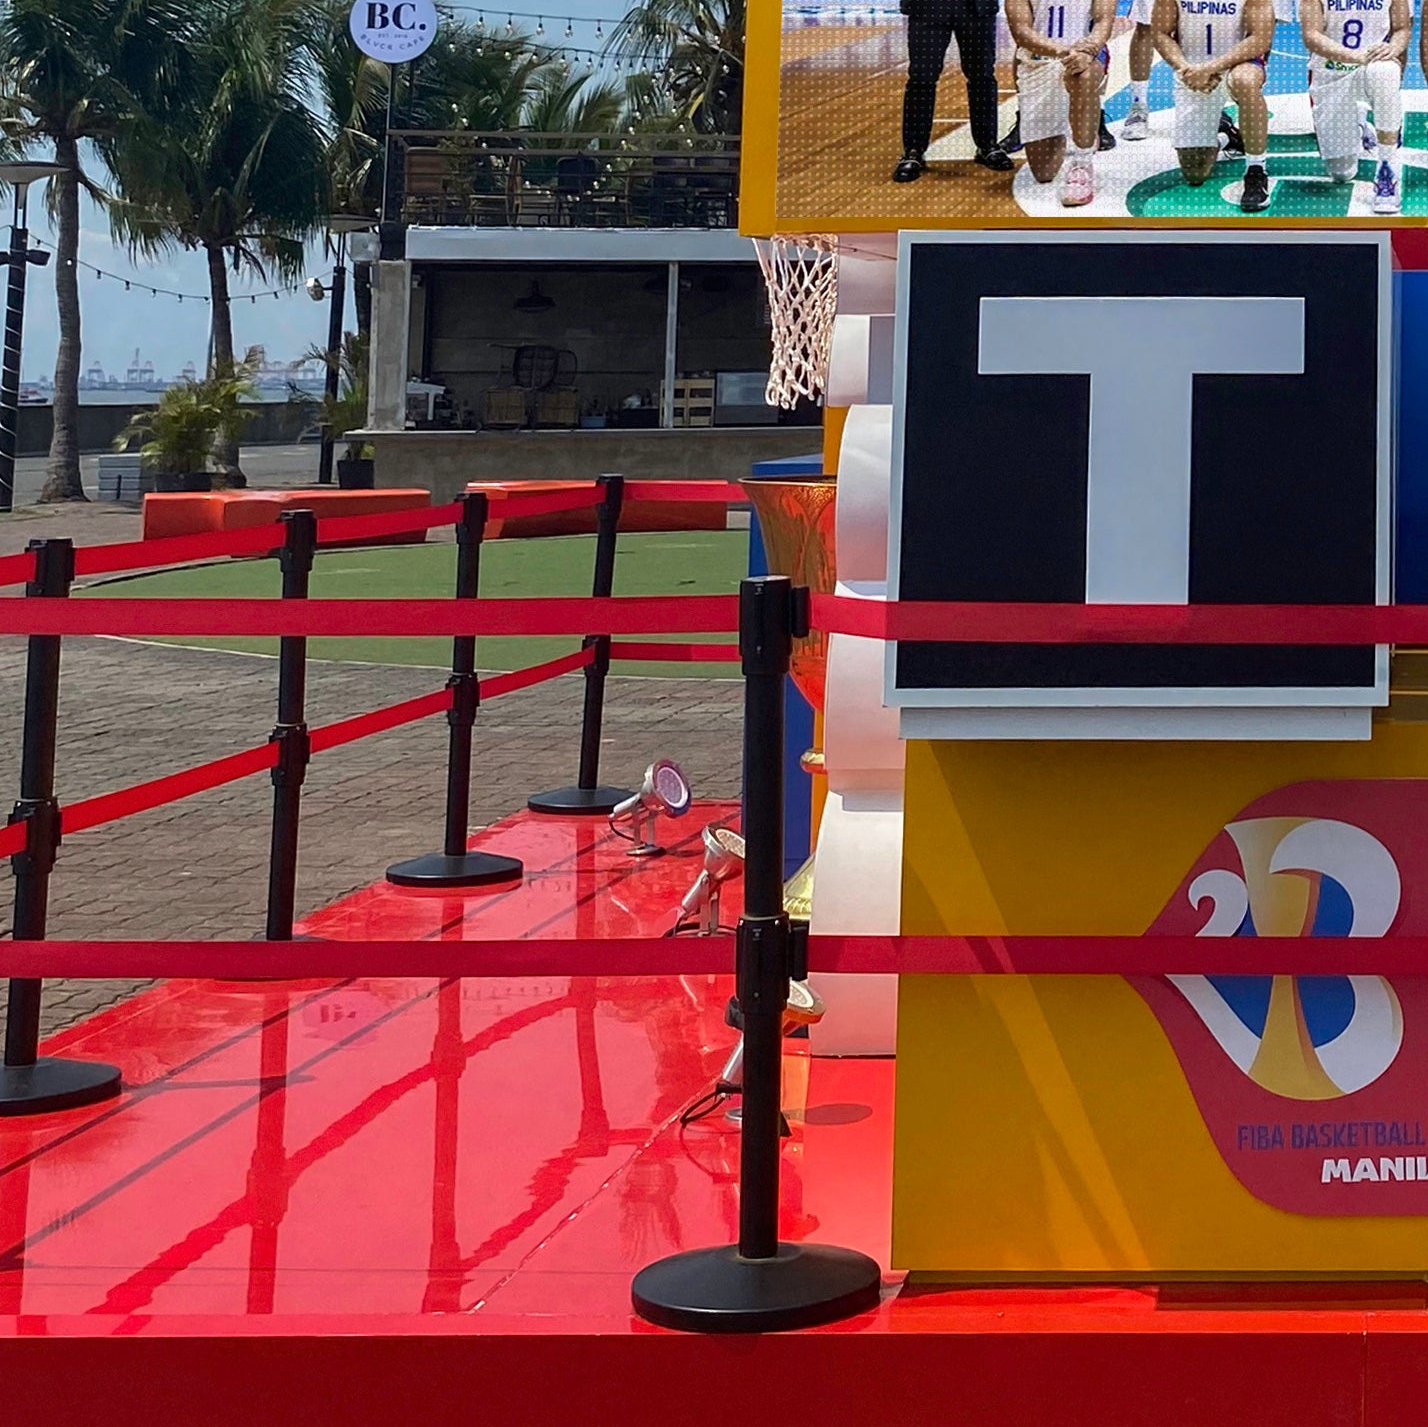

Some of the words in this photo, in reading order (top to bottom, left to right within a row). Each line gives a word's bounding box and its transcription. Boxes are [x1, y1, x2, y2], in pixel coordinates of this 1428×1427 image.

[1048, 5, 1065, 38] 11
[1181, 0, 1236, 15] PILIPINAS
[1206, 24, 1212, 55] 1
[1342, 19, 1363, 49] 8
[978, 296, 1305, 606] T
[1237, 1124, 1284, 1150] FIBA
[1291, 1120, 1426, 1149] BASKETBALL
